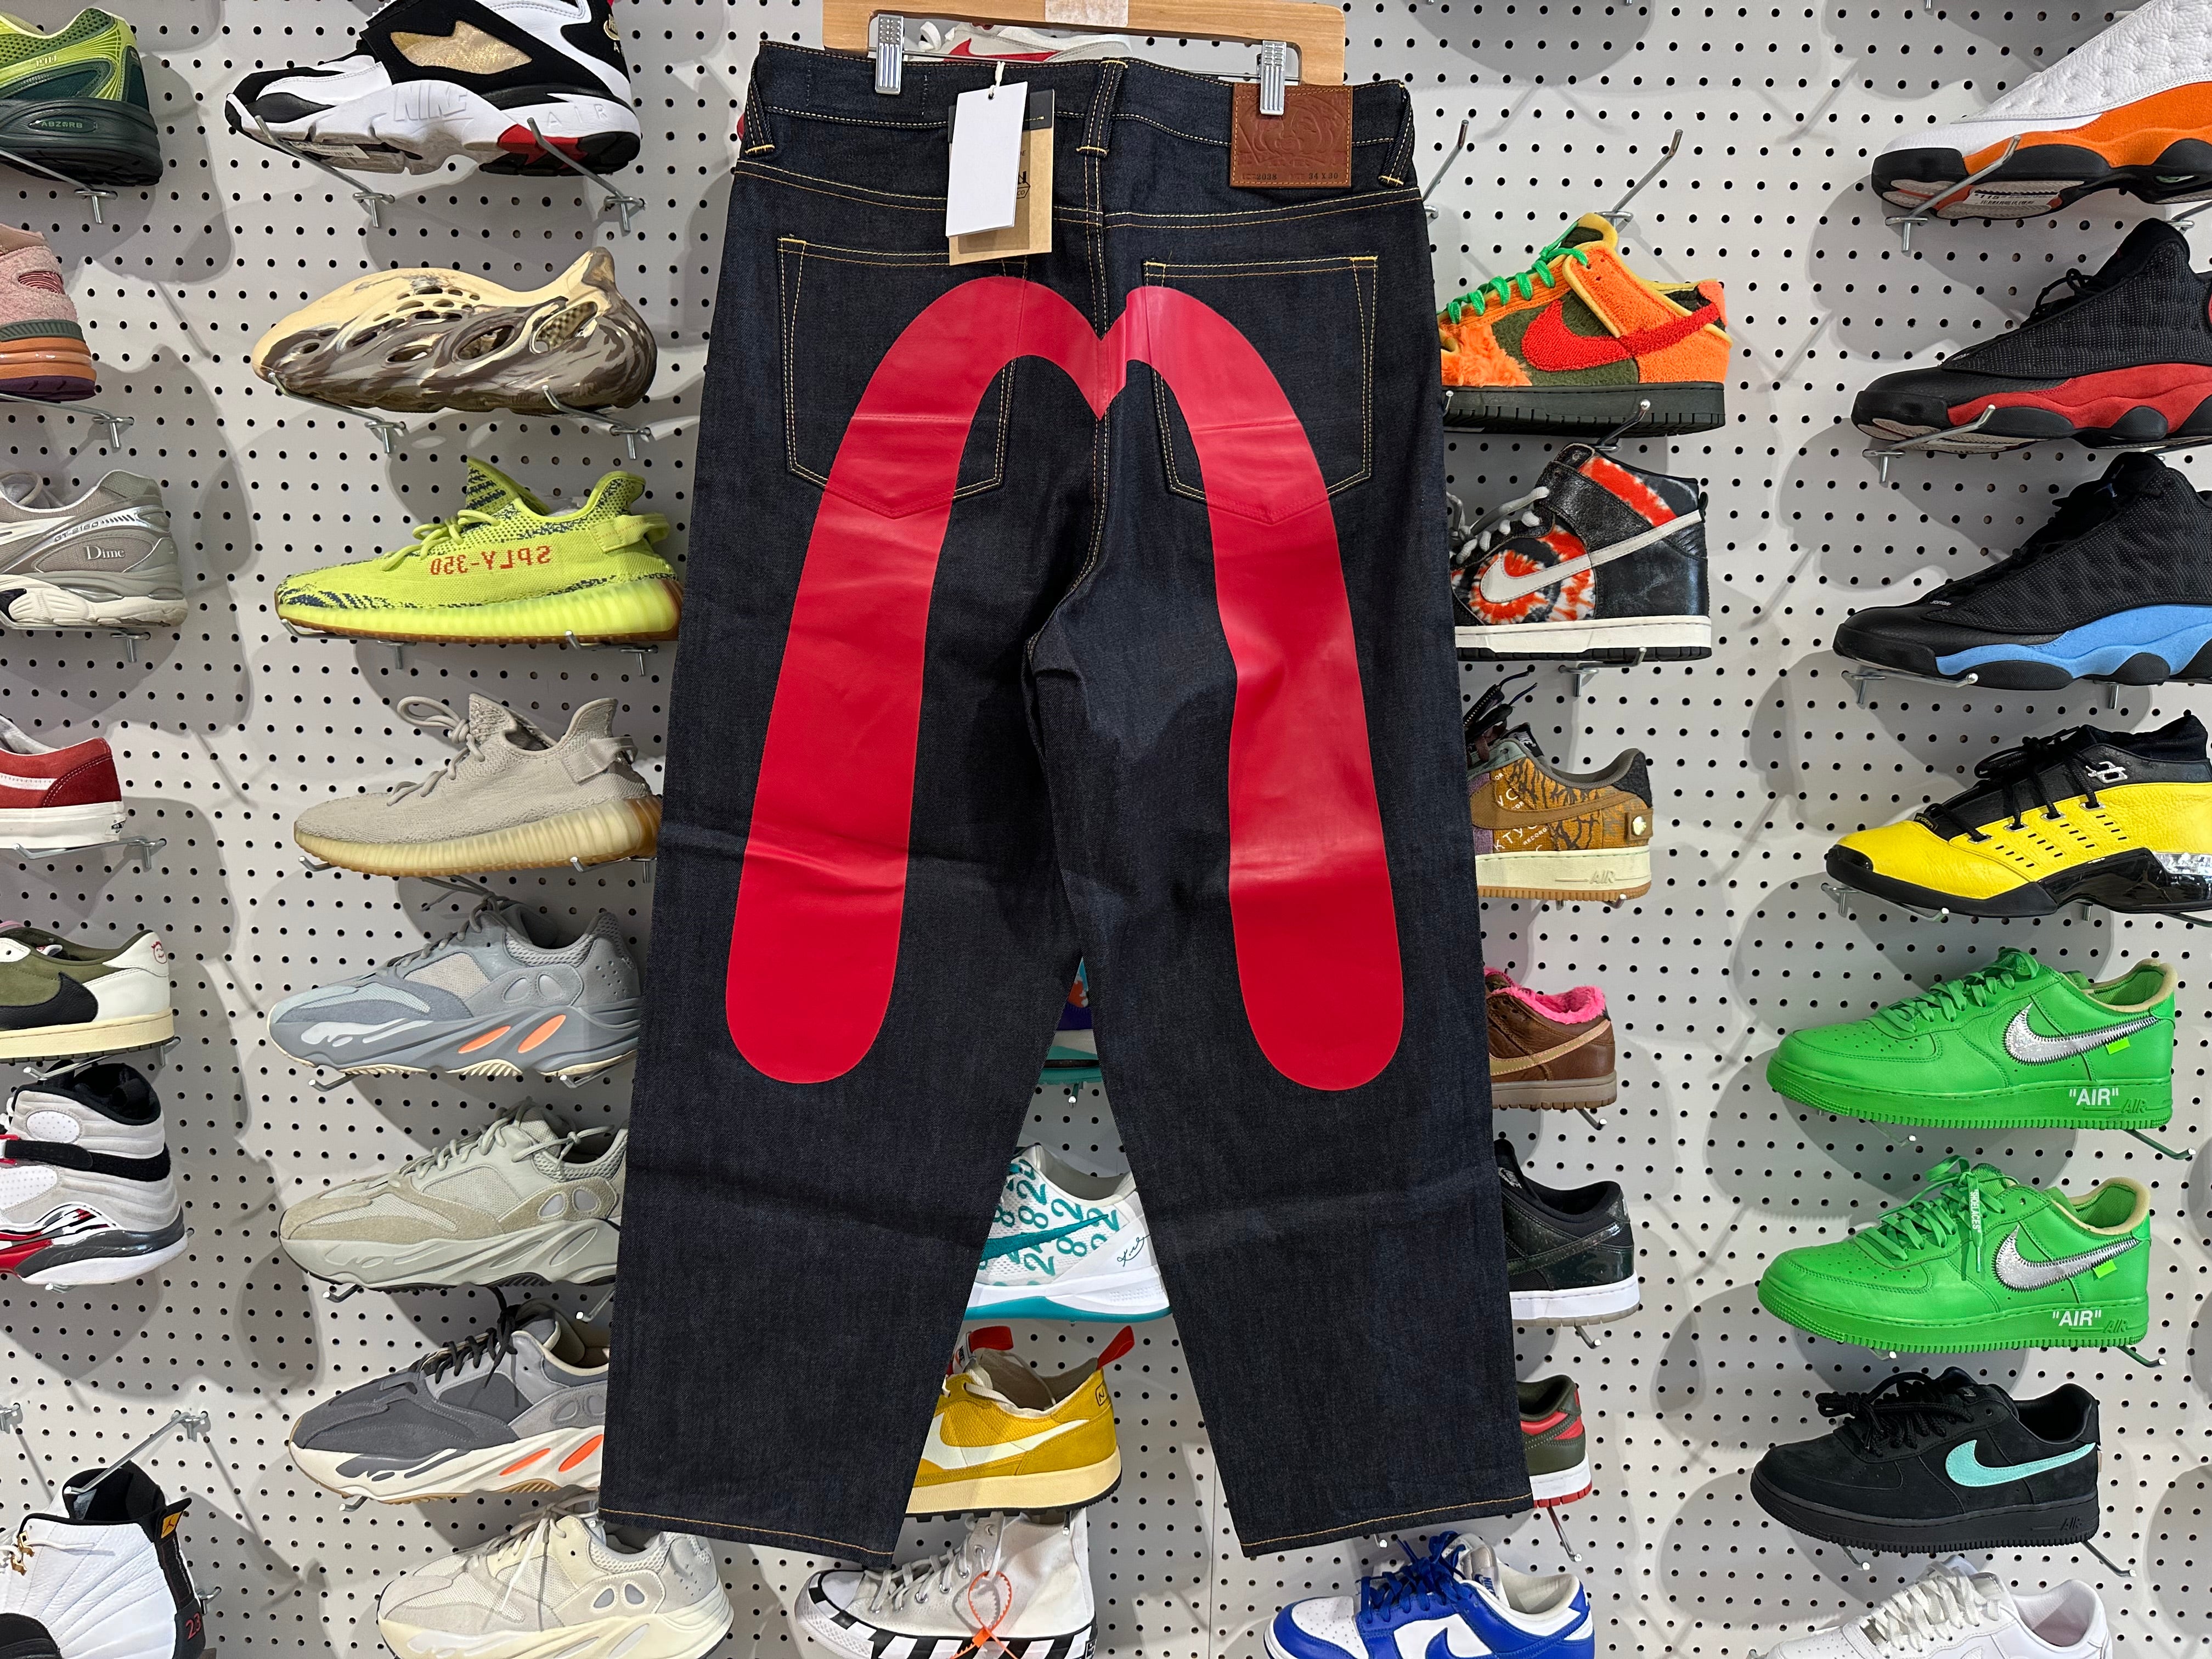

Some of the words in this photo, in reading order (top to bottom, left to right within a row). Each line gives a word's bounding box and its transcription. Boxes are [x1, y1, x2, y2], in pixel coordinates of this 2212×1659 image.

[394, 82, 469, 122] NIKE
[546, 103, 608, 128] AIR
[54, 522, 99, 542] GT-2160
[83, 545, 126, 560] Dime
[1589, 870, 1617, 884] AIR
[2069, 1087, 2119, 1106] "AIR"
[2121, 1098, 2148, 1114] AIR
[2052, 1309, 2102, 1327] "AIR"
[2102, 1318, 2128, 1334] AIR
[2059, 1516, 2082, 1531] AIR
[185, 1612, 202, 1641] 23
